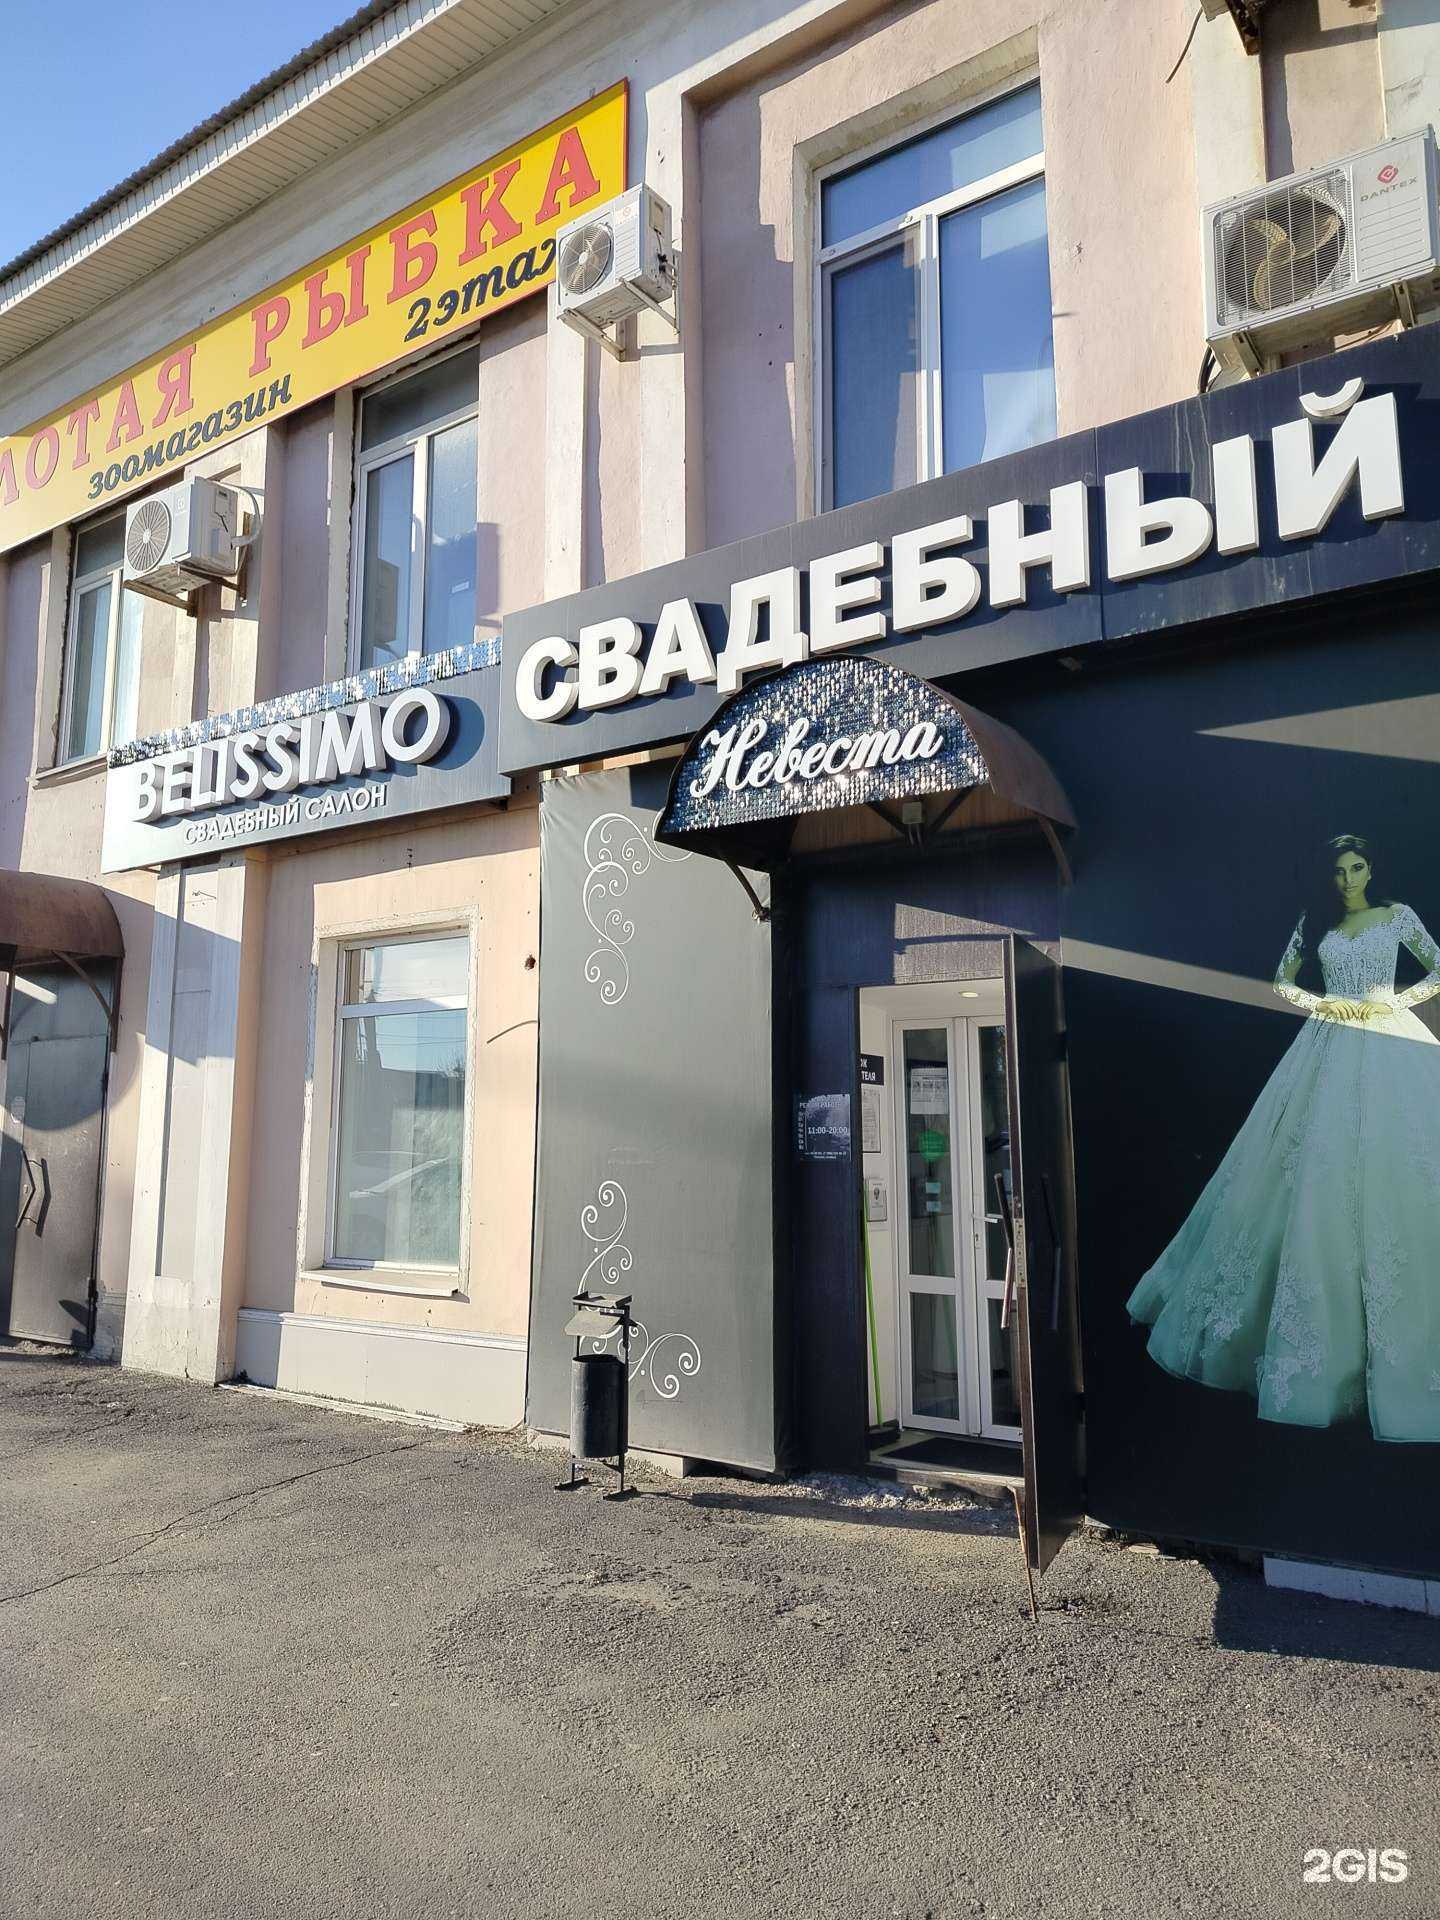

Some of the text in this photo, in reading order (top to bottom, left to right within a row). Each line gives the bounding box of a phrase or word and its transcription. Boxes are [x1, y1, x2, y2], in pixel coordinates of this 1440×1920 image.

[248, 126, 601, 378] РЫБКА
[1360, 176, 1418, 202] DANTEX
[87, 372, 292, 500] зоомагазин
[514, 376, 1405, 724] СВАДЕБНЫЙ
[131, 687, 451, 823] BELISSIMO
[184, 784, 388, 846] СВАДЕБНЫЙ САЛОН
[689, 716, 944, 798] Невеста
